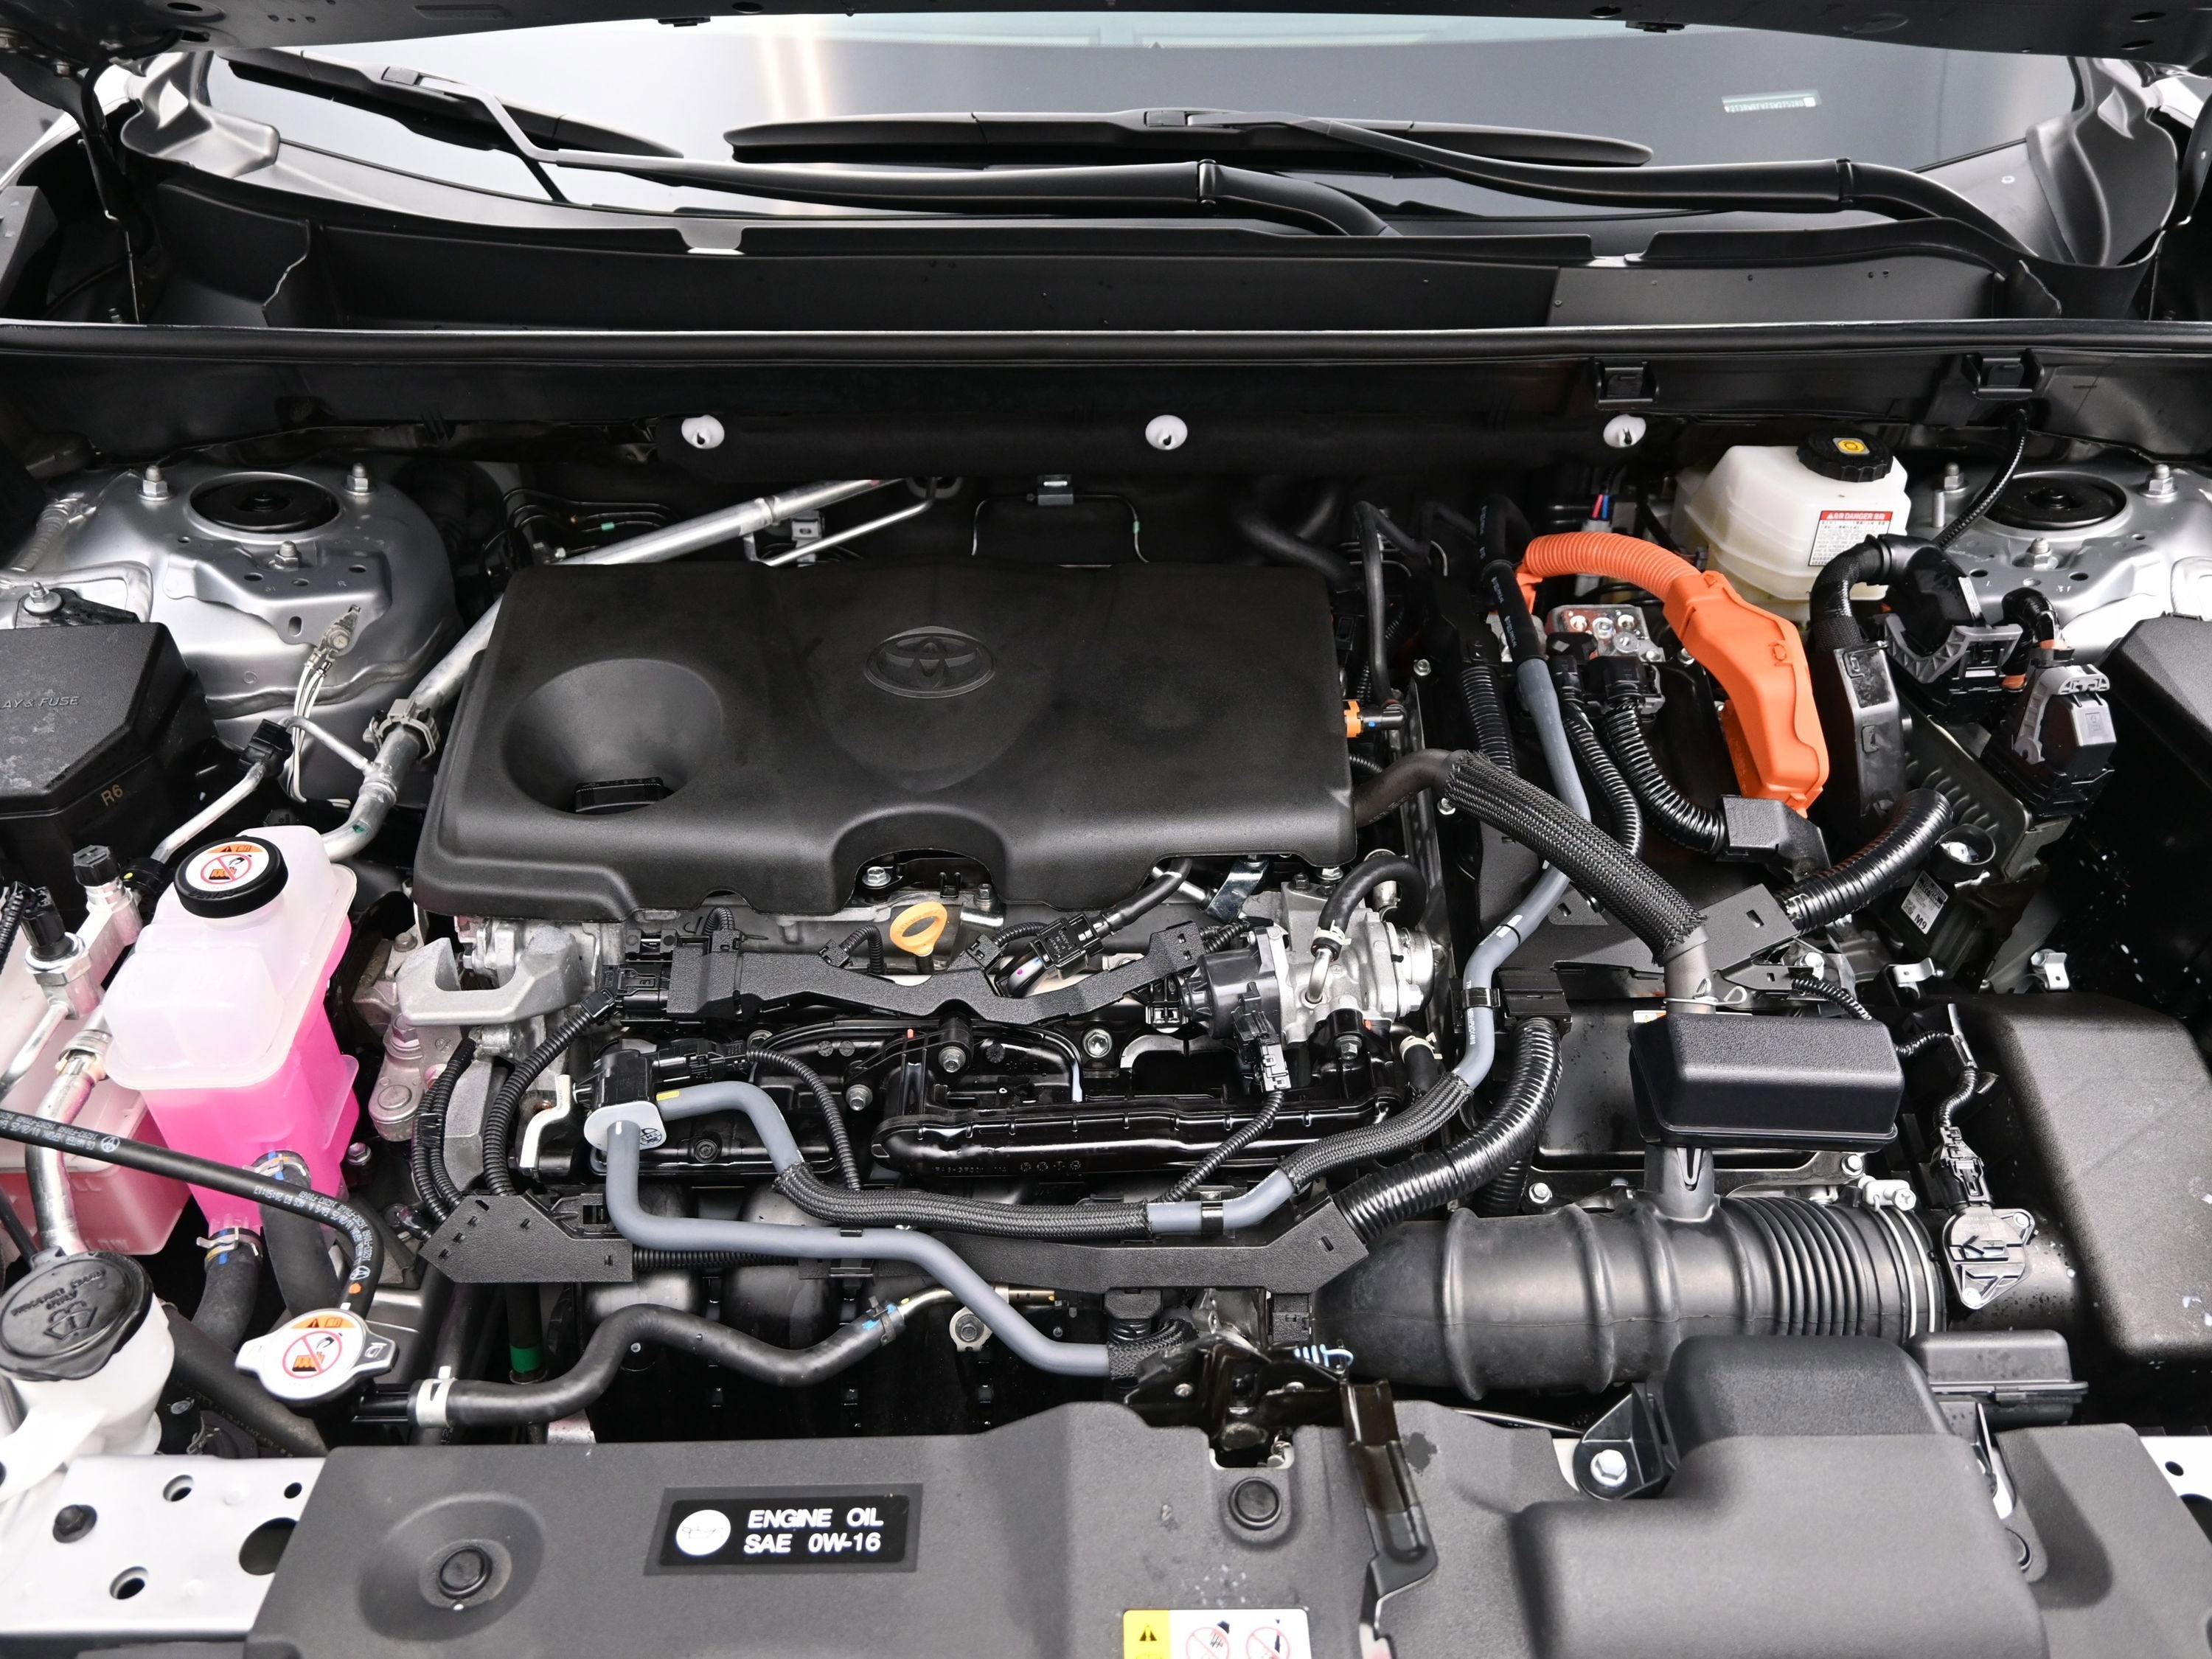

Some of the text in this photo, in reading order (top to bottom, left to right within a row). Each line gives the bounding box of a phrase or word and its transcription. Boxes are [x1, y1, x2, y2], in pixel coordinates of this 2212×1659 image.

[39, 696, 80, 707] FUSE
[101, 784, 123, 806] R6
[1915, 914, 1927, 929] M9
[748, 1507, 884, 1528] ENGINE OIL
[743, 1532, 881, 1554] SAE 0W-16
